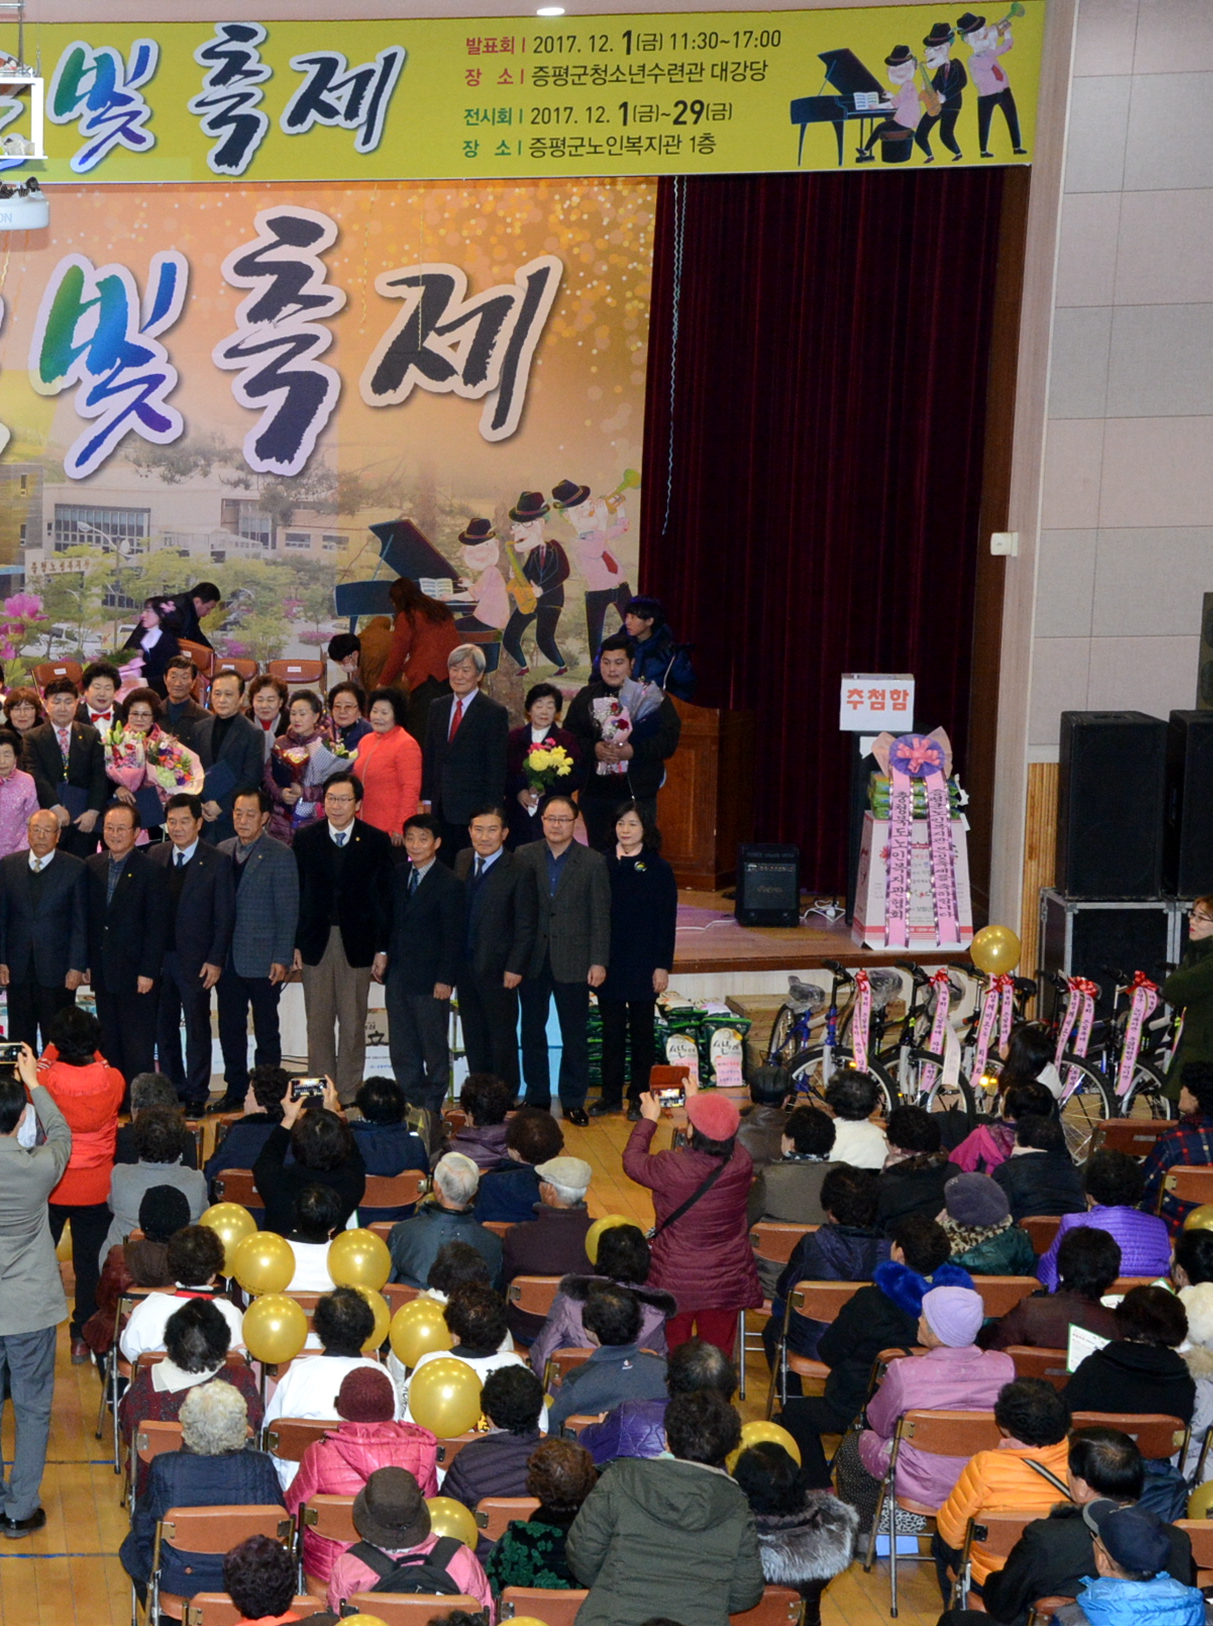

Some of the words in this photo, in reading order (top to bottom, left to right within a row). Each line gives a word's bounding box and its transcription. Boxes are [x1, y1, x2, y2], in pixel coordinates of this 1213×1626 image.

[466, 36, 515, 55] 발표회
[533, 35, 581, 54] 2017.
[589, 35, 614, 53] 12.
[670, 30, 782, 50] 11:30~17:00
[531, 62, 705, 87] 증평군청소년수련관
[711, 60, 768, 82] 대강당
[464, 107, 513, 126] 전시회
[530, 107, 577, 125] 2017.
[585, 106, 610, 124] 12.
[528, 134, 682, 158] 증평군노인복지관
[690, 132, 716, 155] 1층
[846, 688, 909, 711] 추첨함
